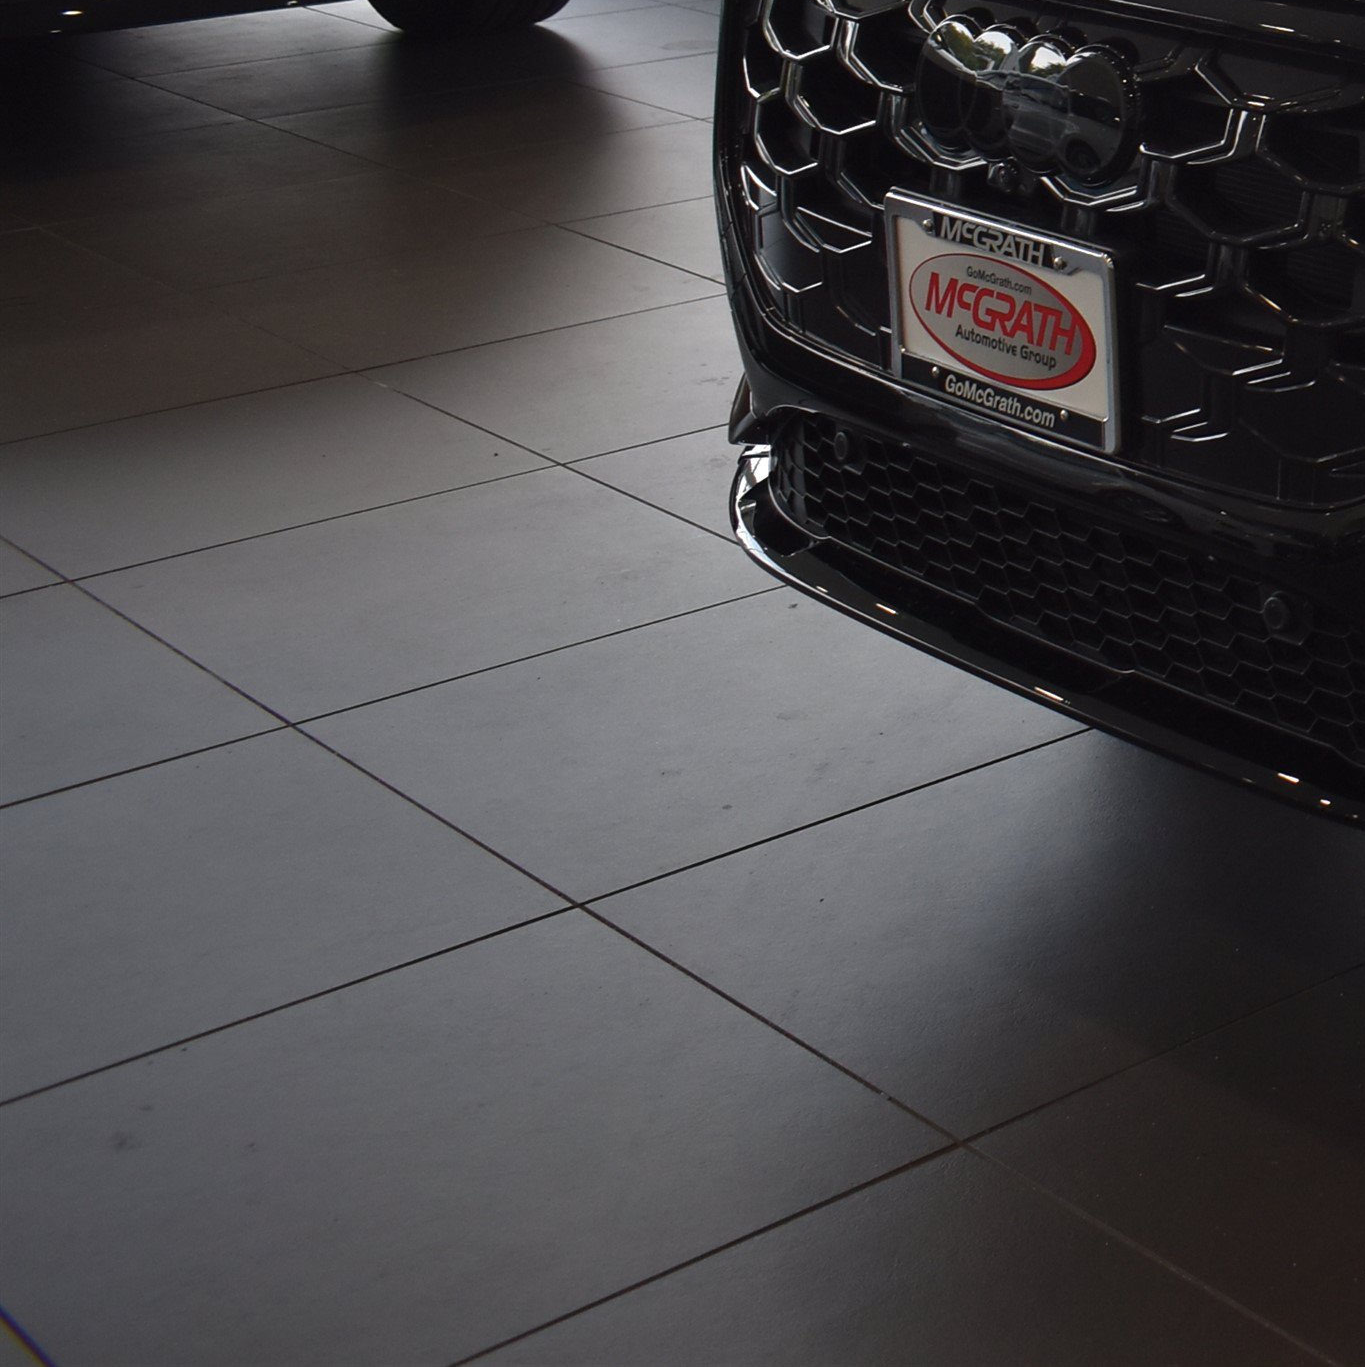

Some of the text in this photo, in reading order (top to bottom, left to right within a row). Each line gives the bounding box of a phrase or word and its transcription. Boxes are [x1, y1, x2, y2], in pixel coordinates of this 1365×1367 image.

[966, 266, 1032, 295] GoMcGrath.com
[955, 324, 1057, 371] Automotive Group
[945, 374, 1056, 428] GoMcGrath.com
